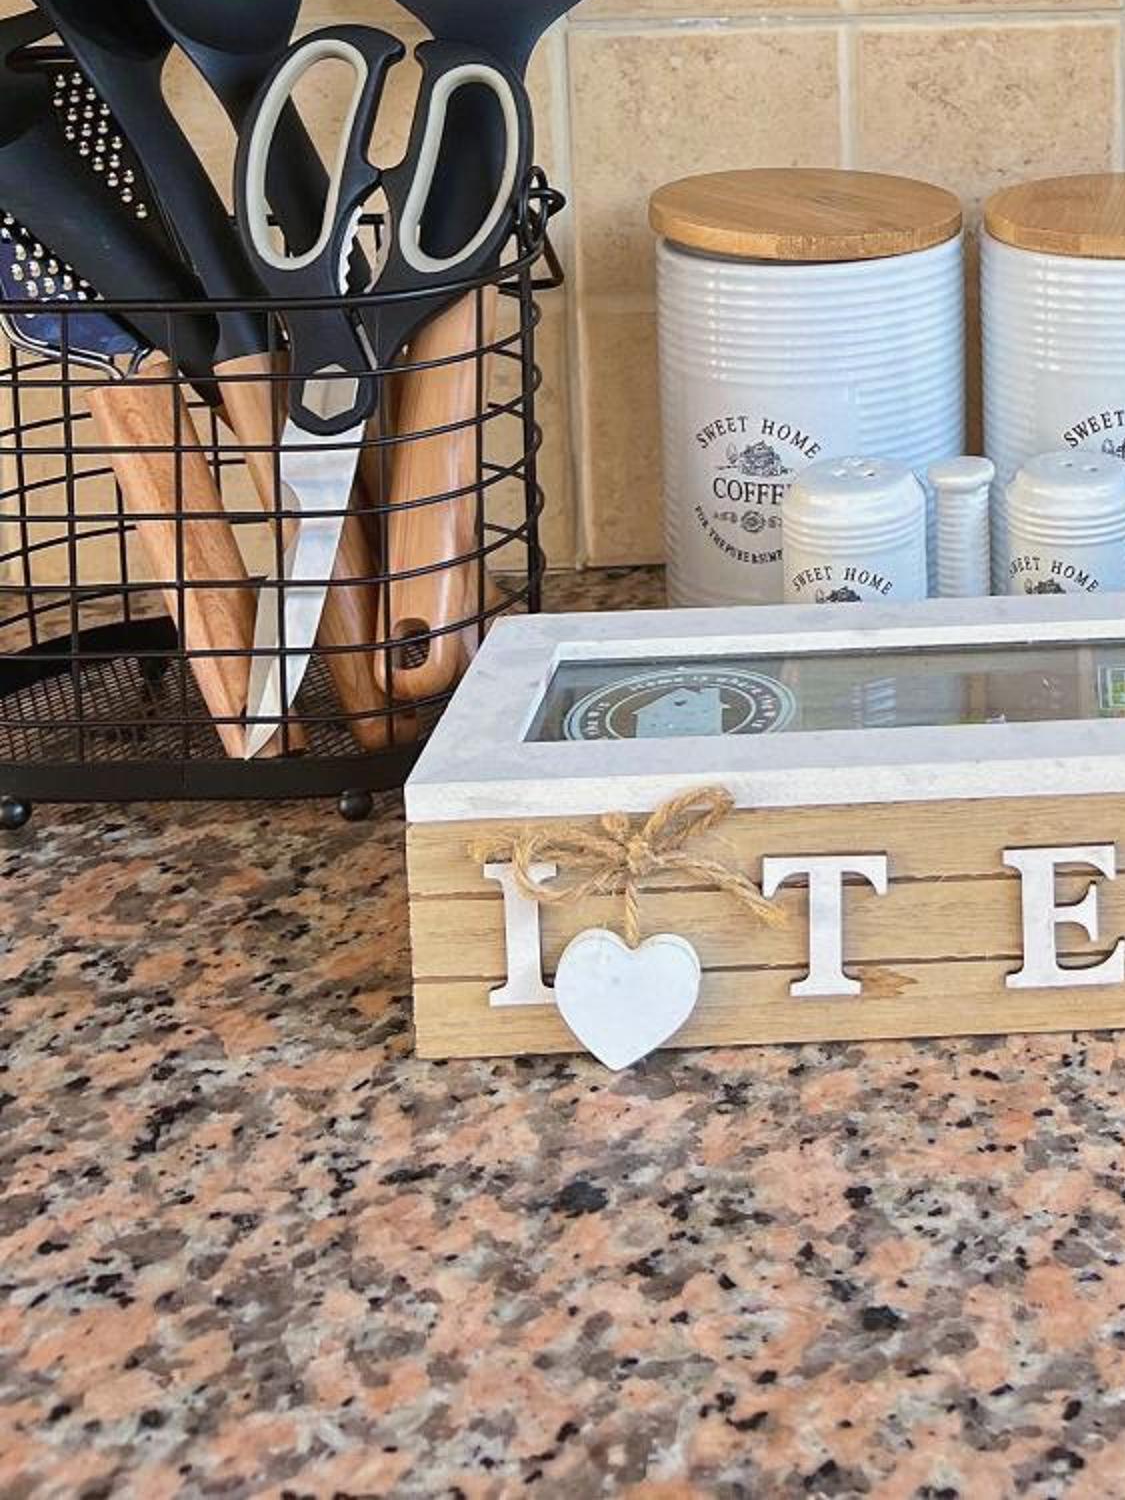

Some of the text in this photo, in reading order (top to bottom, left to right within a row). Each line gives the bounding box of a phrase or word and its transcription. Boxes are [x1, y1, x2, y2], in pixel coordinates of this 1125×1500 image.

[696, 415, 821, 459] SWEET HOME
[1063, 409, 1125, 448] SWEET
[713, 477, 792, 505] COFFE
[792, 565, 893, 597] SWEET HOME
[1051, 560, 1099, 593] HOME
[484, 861, 557, 1008] I
